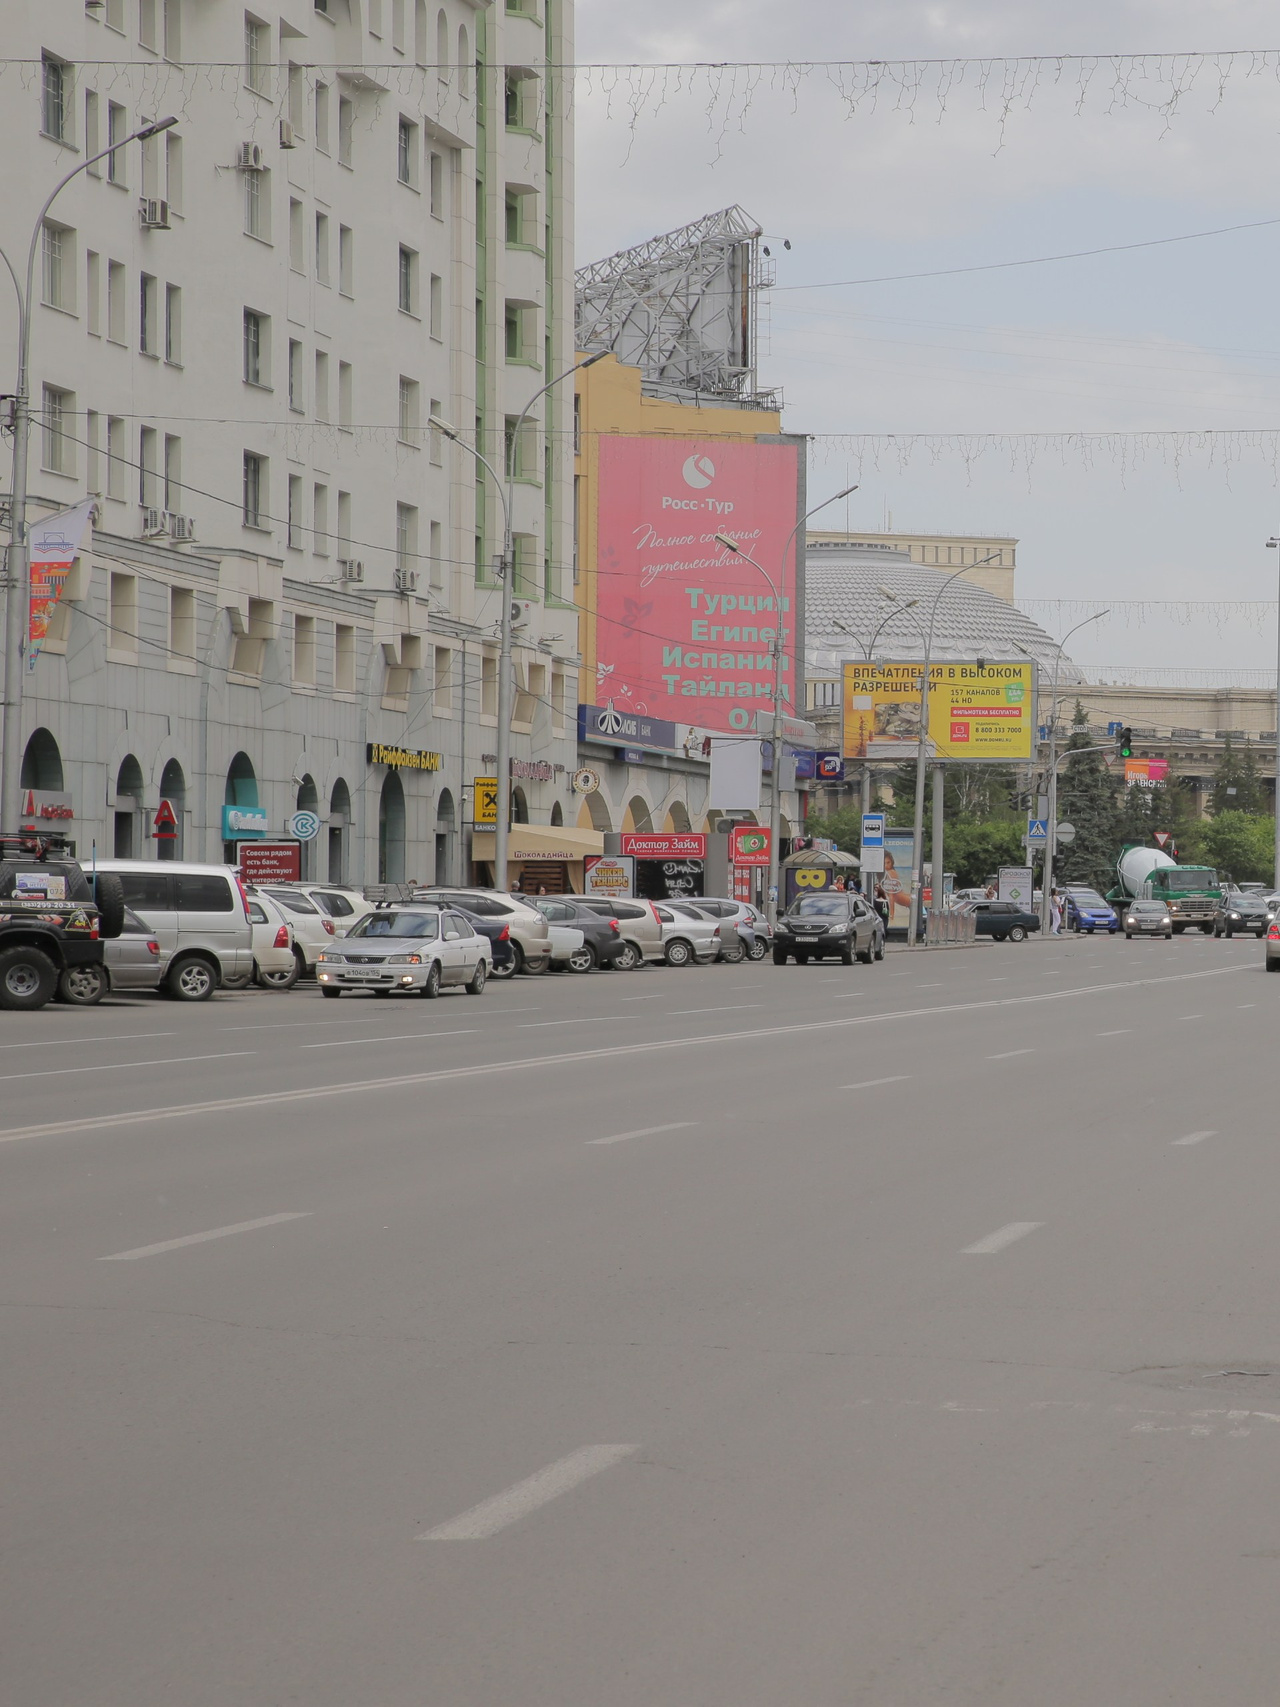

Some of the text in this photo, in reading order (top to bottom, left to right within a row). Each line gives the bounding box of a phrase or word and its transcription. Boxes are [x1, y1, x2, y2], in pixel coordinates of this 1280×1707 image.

[632, 523, 696, 550] Полное
[684, 587, 790, 615] Турция
[853, 668, 1022, 678] ВПЕЧАТЛЕНИЯ В ВЫСОКОМ
[853, 682, 937, 692] РАЗРЕШЕНИ
[379, 744, 440, 771] Райффайзен БАНК
[1127, 770, 1148, 780] Игорь
[627, 838, 699, 852] Доктор Займ
[258, 867, 293, 875] действуют
[595, 867, 624, 877] ЧИКЕН
[591, 876, 629, 888] ТЕНДЕРС
